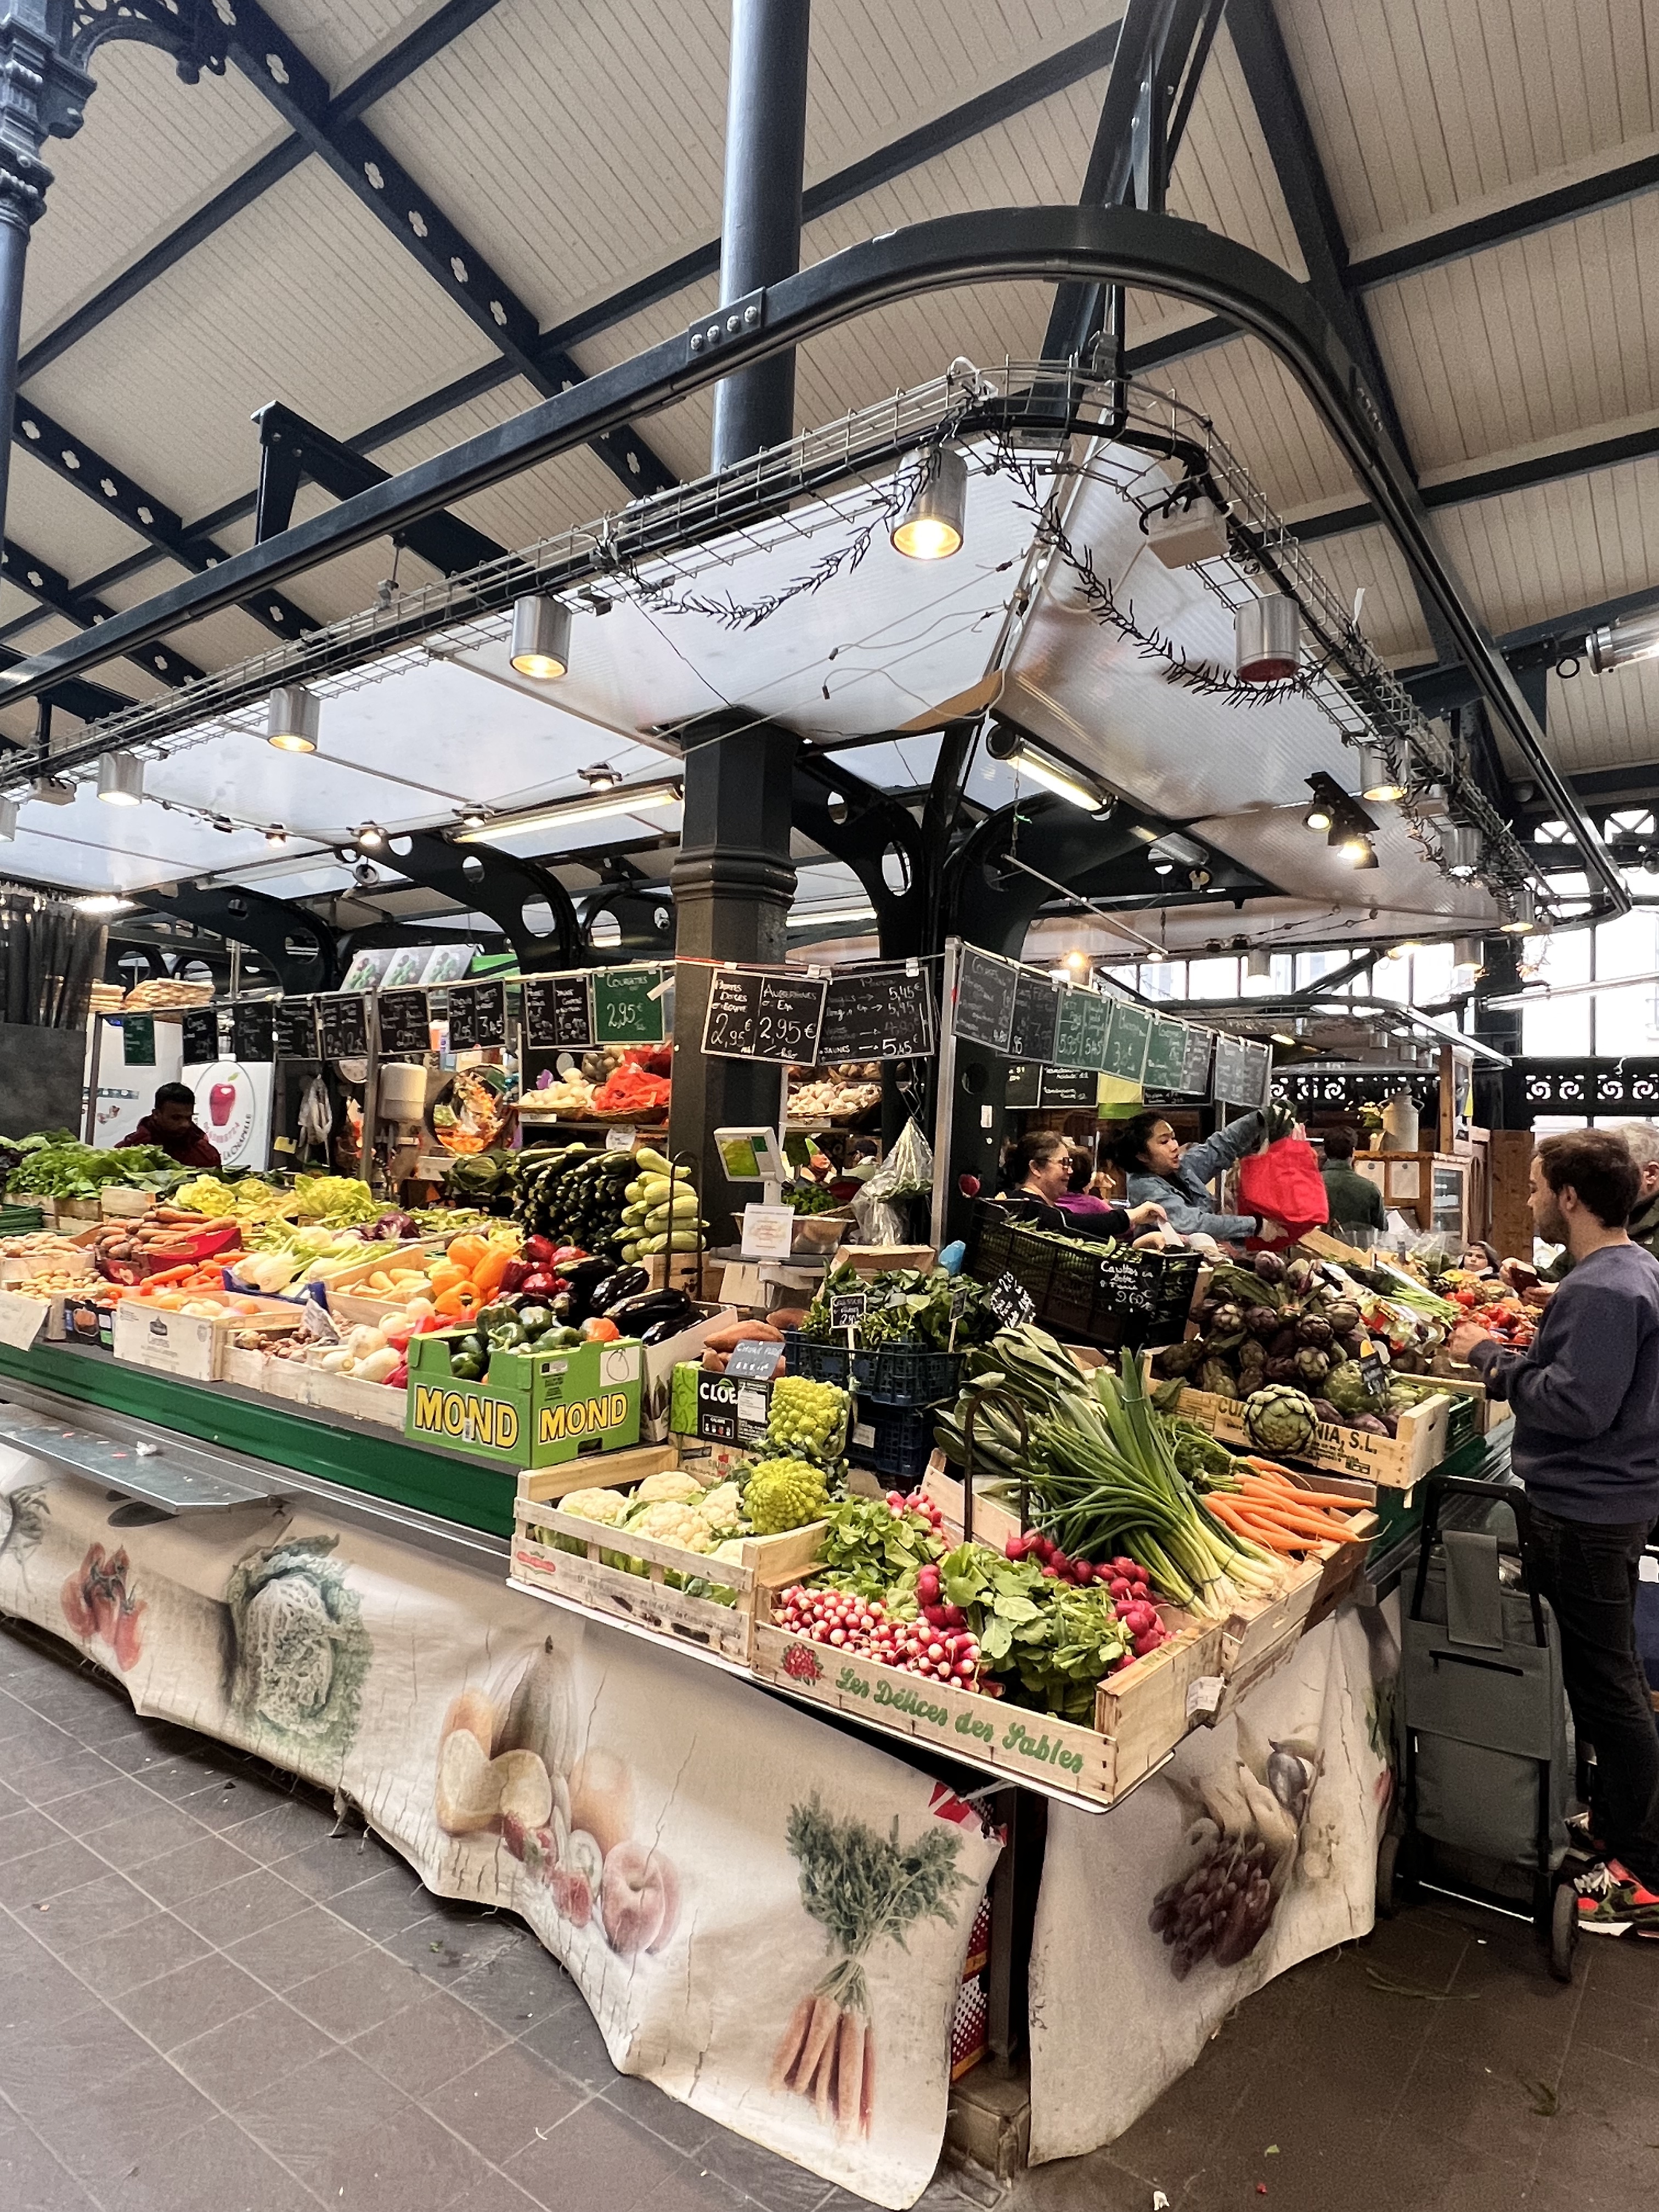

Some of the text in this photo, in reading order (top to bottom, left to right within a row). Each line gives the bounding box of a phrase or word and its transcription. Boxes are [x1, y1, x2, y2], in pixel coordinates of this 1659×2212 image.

[415, 1384, 519, 1449] MOND
[539, 1392, 628, 1445] MOND
[836, 1667, 1084, 1774] Les Délices des Sables
